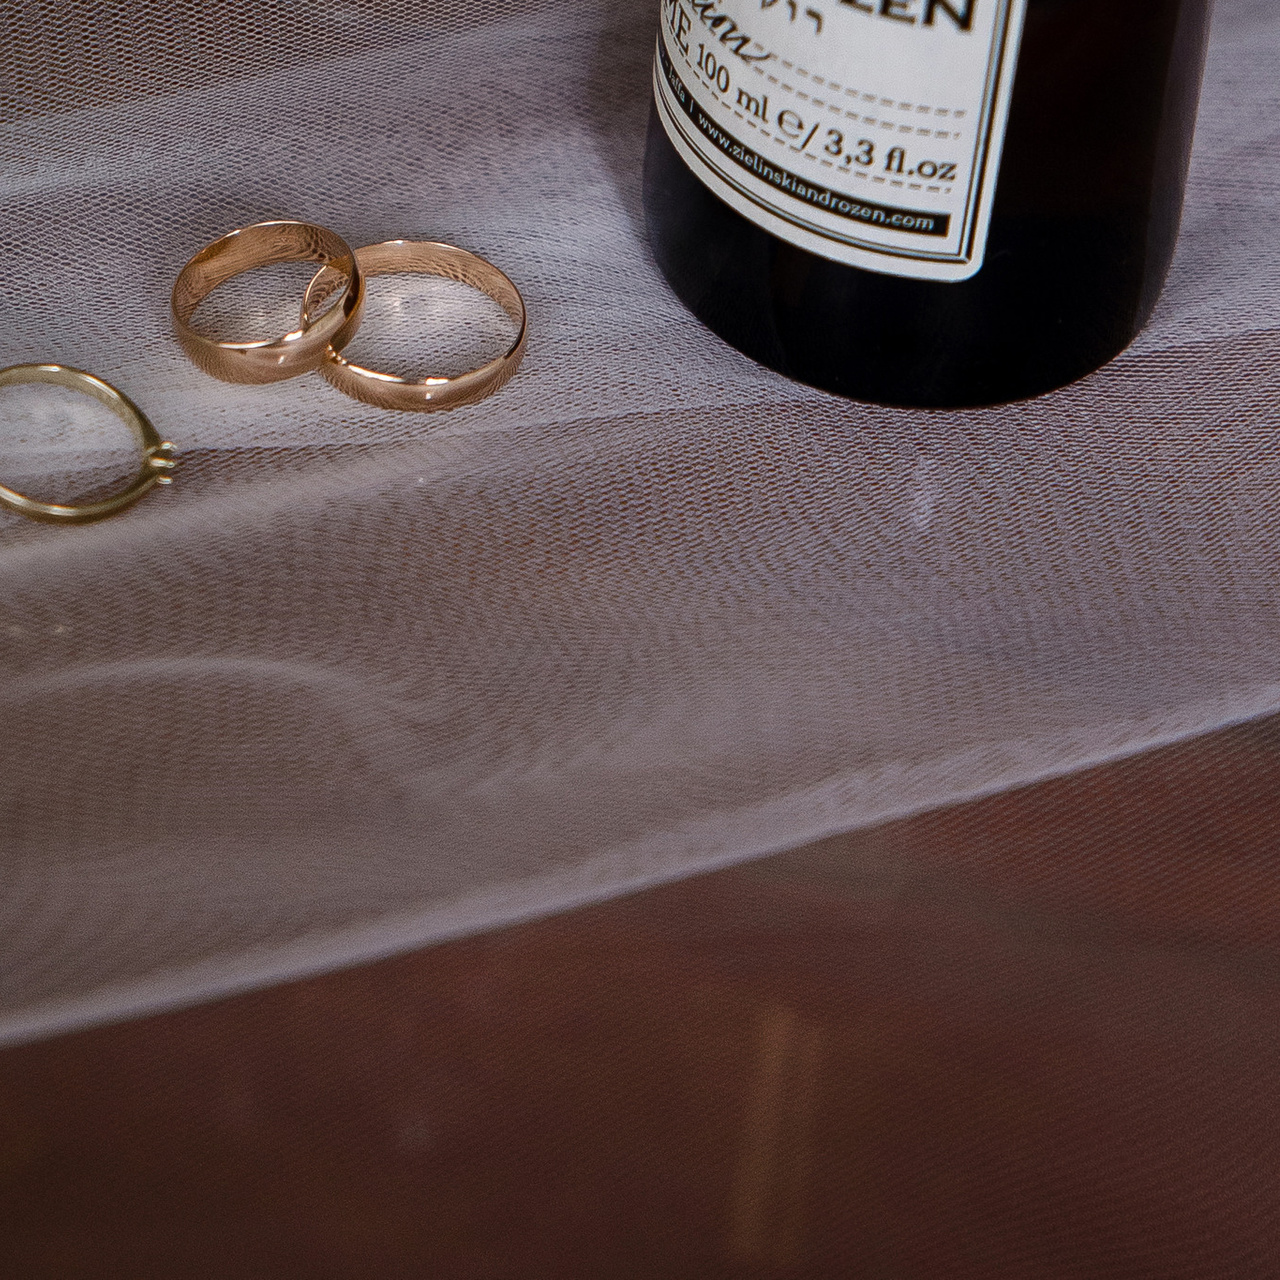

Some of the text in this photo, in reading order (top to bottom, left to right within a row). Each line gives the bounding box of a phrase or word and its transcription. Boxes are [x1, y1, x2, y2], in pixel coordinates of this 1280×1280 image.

[696, 43, 730, 94] 100
[736, 86, 770, 124] ml
[697, 111, 936, 233] www.zielinskiandrozen.com
